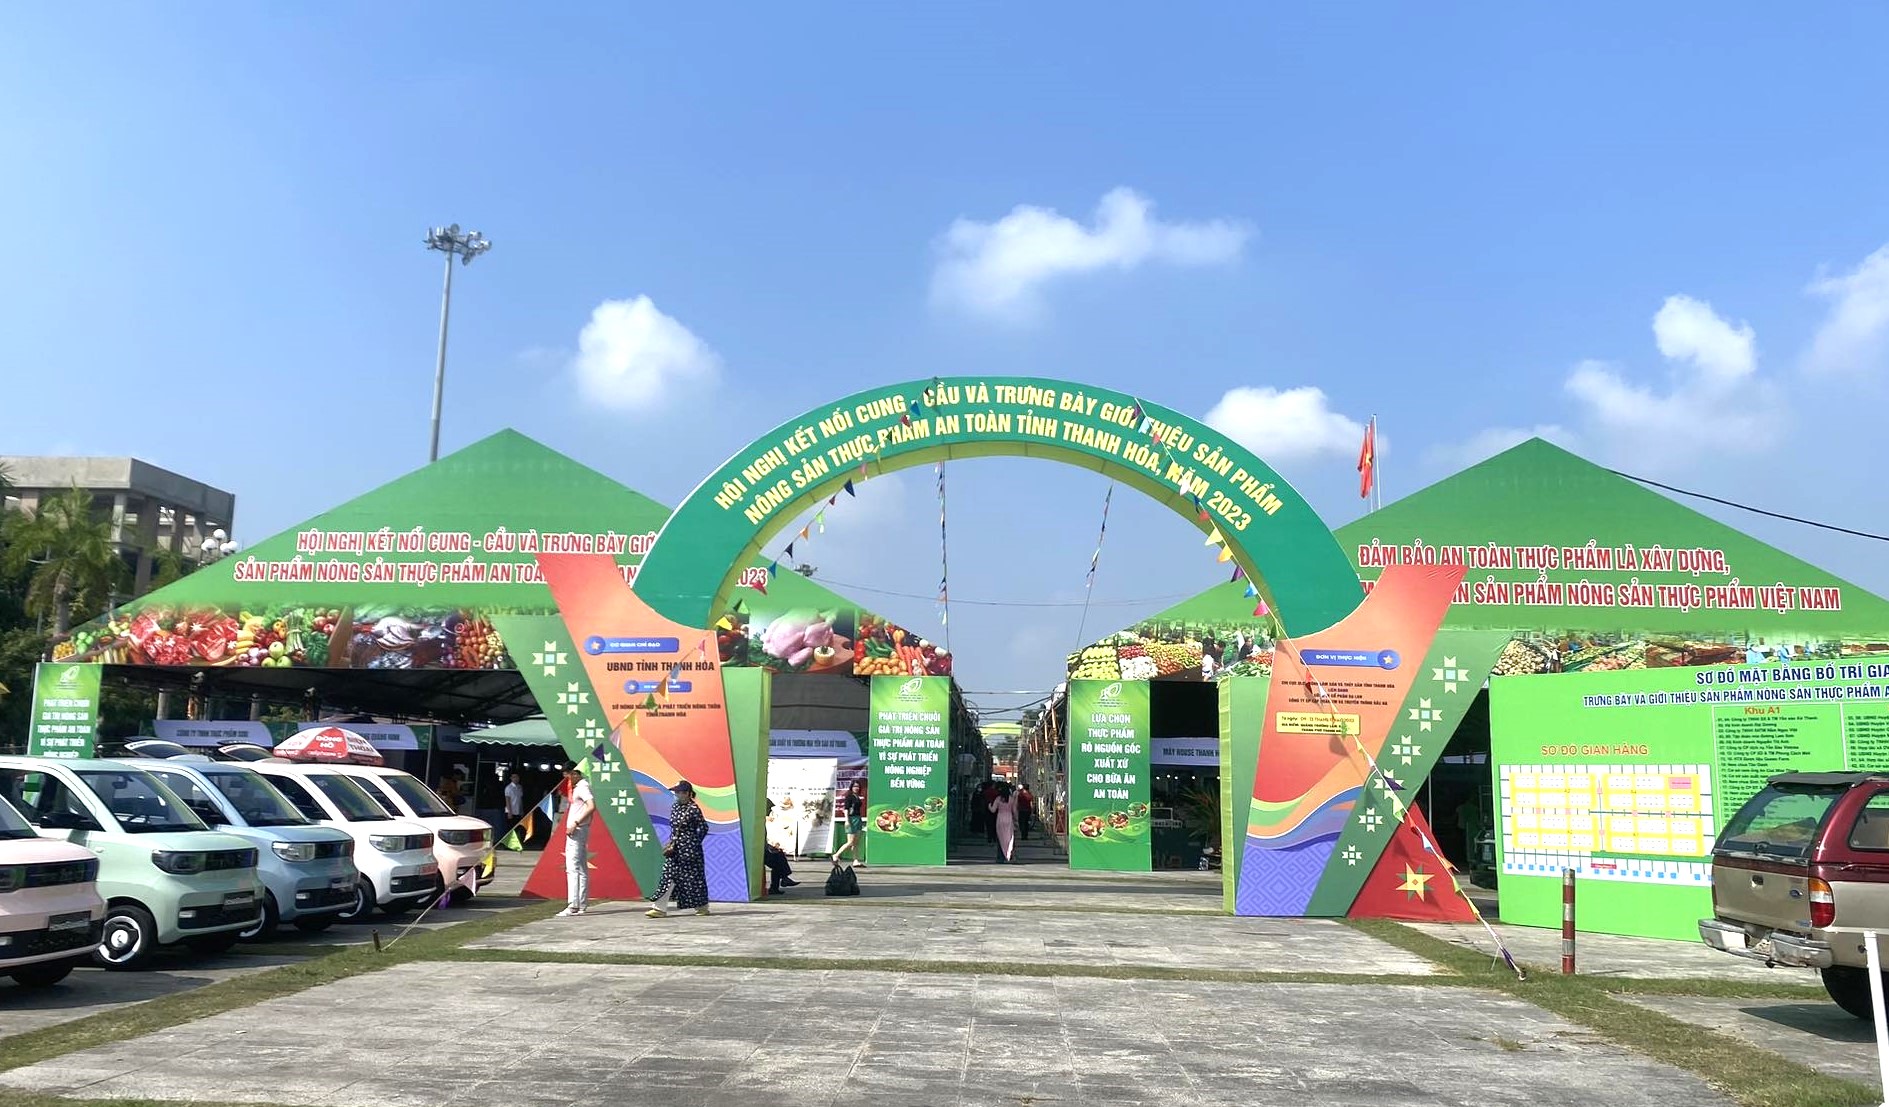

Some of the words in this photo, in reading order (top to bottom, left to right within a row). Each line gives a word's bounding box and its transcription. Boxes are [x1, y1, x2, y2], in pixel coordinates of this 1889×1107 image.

[714, 481, 748, 511] HỘI
[742, 446, 788, 485] NGHỊ
[783, 424, 819, 457] KẾT
[819, 407, 853, 439] NỐI
[855, 394, 907, 424] CUNG
[922, 382, 960, 407] CẦU
[965, 382, 989, 403] VÀ
[994, 385, 1055, 408] TRƯNG
[1060, 391, 1097, 416] BÀY
[1100, 402, 1138, 429] GIỚI
[1193, 443, 1234, 477] SẢN
[1229, 468, 1283, 516] PHẨM
[744, 479, 793, 525] NÔNG
[791, 457, 829, 488] SẢN
[827, 434, 875, 467] THỰC
[935, 414, 960, 435] AN
[965, 411, 1010, 434] TOÀN
[1017, 409, 1057, 438] TỈNH
[1063, 421, 1121, 455] THANH
[1123, 441, 1161, 476] HÓA,
[1164, 461, 1210, 500] NĂM
[1207, 491, 1251, 531] 2023
[297, 529, 323, 556] HỘI
[327, 532, 363, 555] NGHỊ
[367, 527, 394, 552] KẾT
[399, 526, 425, 552] NỐI
[428, 532, 470, 552] CUNG
[484, 527, 515, 552] CẦU
[518, 528, 539, 553] VÀ
[543, 531, 592, 553] TRƯNG
[597, 528, 625, 553] BÀY
[631, 531, 656, 554] GIỚ
[1359, 539, 1397, 566] ĐẢM
[1402, 539, 1434, 565] BẢO
[1441, 547, 1464, 565] AN
[1469, 543, 1511, 568] TOÀN
[1516, 546, 1558, 573] THỰC
[1563, 540, 1611, 569] PHẨM
[1617, 545, 1636, 570] LÀ
[1641, 545, 1673, 571] XÂY
[1678, 549, 1730, 575] DỰNG,
[235, 557, 265, 581] SẢN
[269, 556, 313, 581] PHẨM
[316, 562, 358, 582] NÔNG
[363, 558, 396, 581] SẢN
[399, 562, 437, 586] THỰC
[442, 556, 485, 582] PHẨM
[490, 564, 510, 582] AN
[515, 561, 547, 583] TOÀ
[736, 568, 767, 587] 023
[1475, 576, 1509, 604] SẢN
[1515, 576, 1562, 604] PHẨM
[1568, 581, 1613, 606] NÔNG
[1619, 578, 1652, 606] SẢN
[1658, 584, 1701, 612] THỰC
[1705, 578, 1754, 608] PHẨM
[1759, 583, 1795, 613] VIỆT
[1800, 587, 1841, 610] NAM
[607, 662, 633, 671] UBND
[636, 659, 658, 671] TỈNH
[695, 660, 714, 671] HÓA
[1696, 671, 1713, 684] SƠ
[1718, 667, 1735, 683] ĐỒ
[1740, 668, 1768, 684] MẶT
[1773, 663, 1811, 681] BẰNG
[1816, 662, 1835, 680] BỐ
[1839, 663, 1862, 679] TRÍ
[1867, 664, 1889, 678] GIA
[1584, 695, 1612, 706] TRƯNG
[1614, 693, 1631, 705] BÀY
[1634, 692, 1646, 704] VÀ
[1648, 692, 1667, 704] GIỚI
[1670, 690, 1697, 705] THIỆU
[1700, 688, 1720, 702] SẢN
[1723, 686, 1753, 701] PHẨM
[1757, 687, 1785, 700] NÔNG
[1789, 684, 1812, 699] SẢN
[1815, 686, 1843, 701] THỰC
[1847, 681, 1880, 698] PHẨM
[1745, 707, 1765, 715] Khu
[1767, 706, 1780, 714] A1
[878, 724, 890, 733] GIÁ
[892, 725, 902, 735] TRỊ
[904, 725, 923, 734] NÔNG
[925, 724, 940, 734] SẢN
[1088, 728, 1108, 740] THỰC
[1111, 726, 1134, 738] PHẨM
[873, 738, 891, 748] THỰC
[893, 736, 913, 747] PHẨM
[926, 738, 944, 748] TOÀN
[1541, 744, 1556, 755] SƠ
[1561, 744, 1577, 755] ĐỒ
[1581, 745, 1609, 755] GIAN
[1613, 743, 1648, 755] HÀNG
[879, 751, 886, 760] VÌ
[887, 752, 898, 762] SỰ
[899, 751, 916, 761] PHÁT
[918, 750, 938, 761] TRIỂN
[1094, 756, 1115, 768] XUẤT
[1117, 757, 1129, 768] XỨ
[885, 764, 904, 774] NÔNG
[906, 765, 931, 776] NGHIỆP
[1087, 773, 1103, 783] CHO
[1105, 772, 1122, 783] BỮA
[1124, 773, 1136, 784] ĂN
[1093, 789, 1105, 798] AN
[1107, 788, 1129, 799] TOÀN
